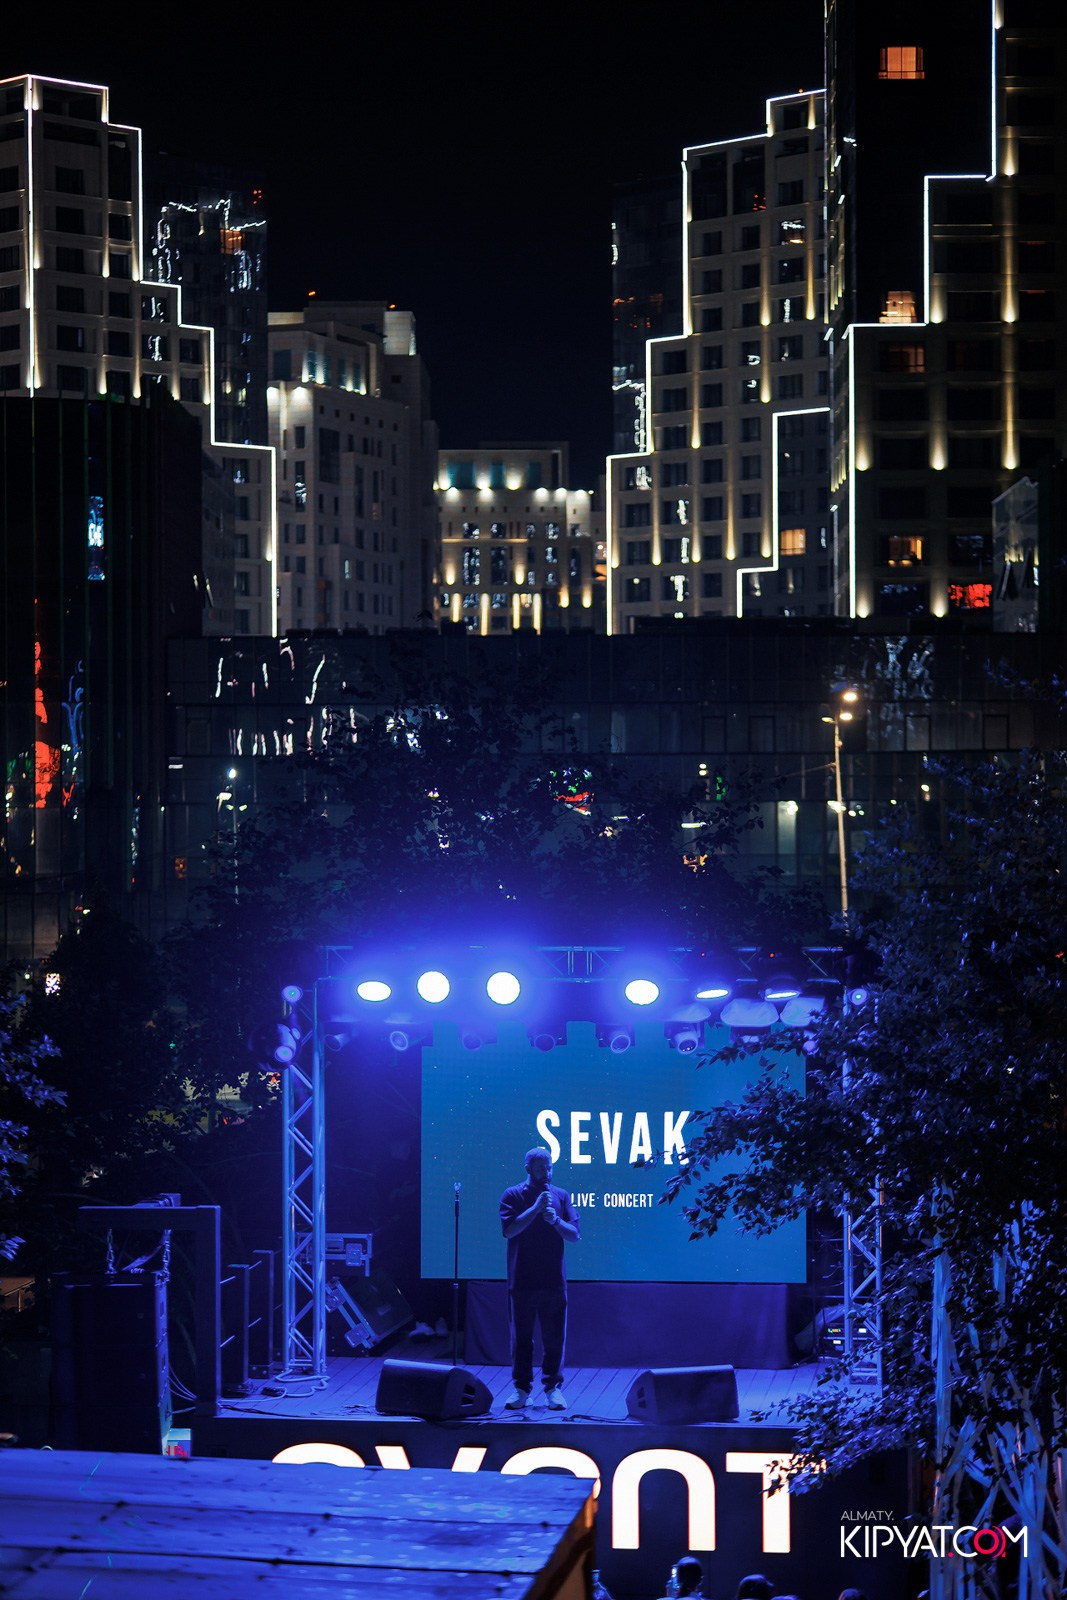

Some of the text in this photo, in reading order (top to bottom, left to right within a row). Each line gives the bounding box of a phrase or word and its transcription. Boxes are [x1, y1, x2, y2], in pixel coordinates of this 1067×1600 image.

[536, 1109, 690, 1165] SEVAK
[571, 1193, 653, 1208] LIVE CONCERT
